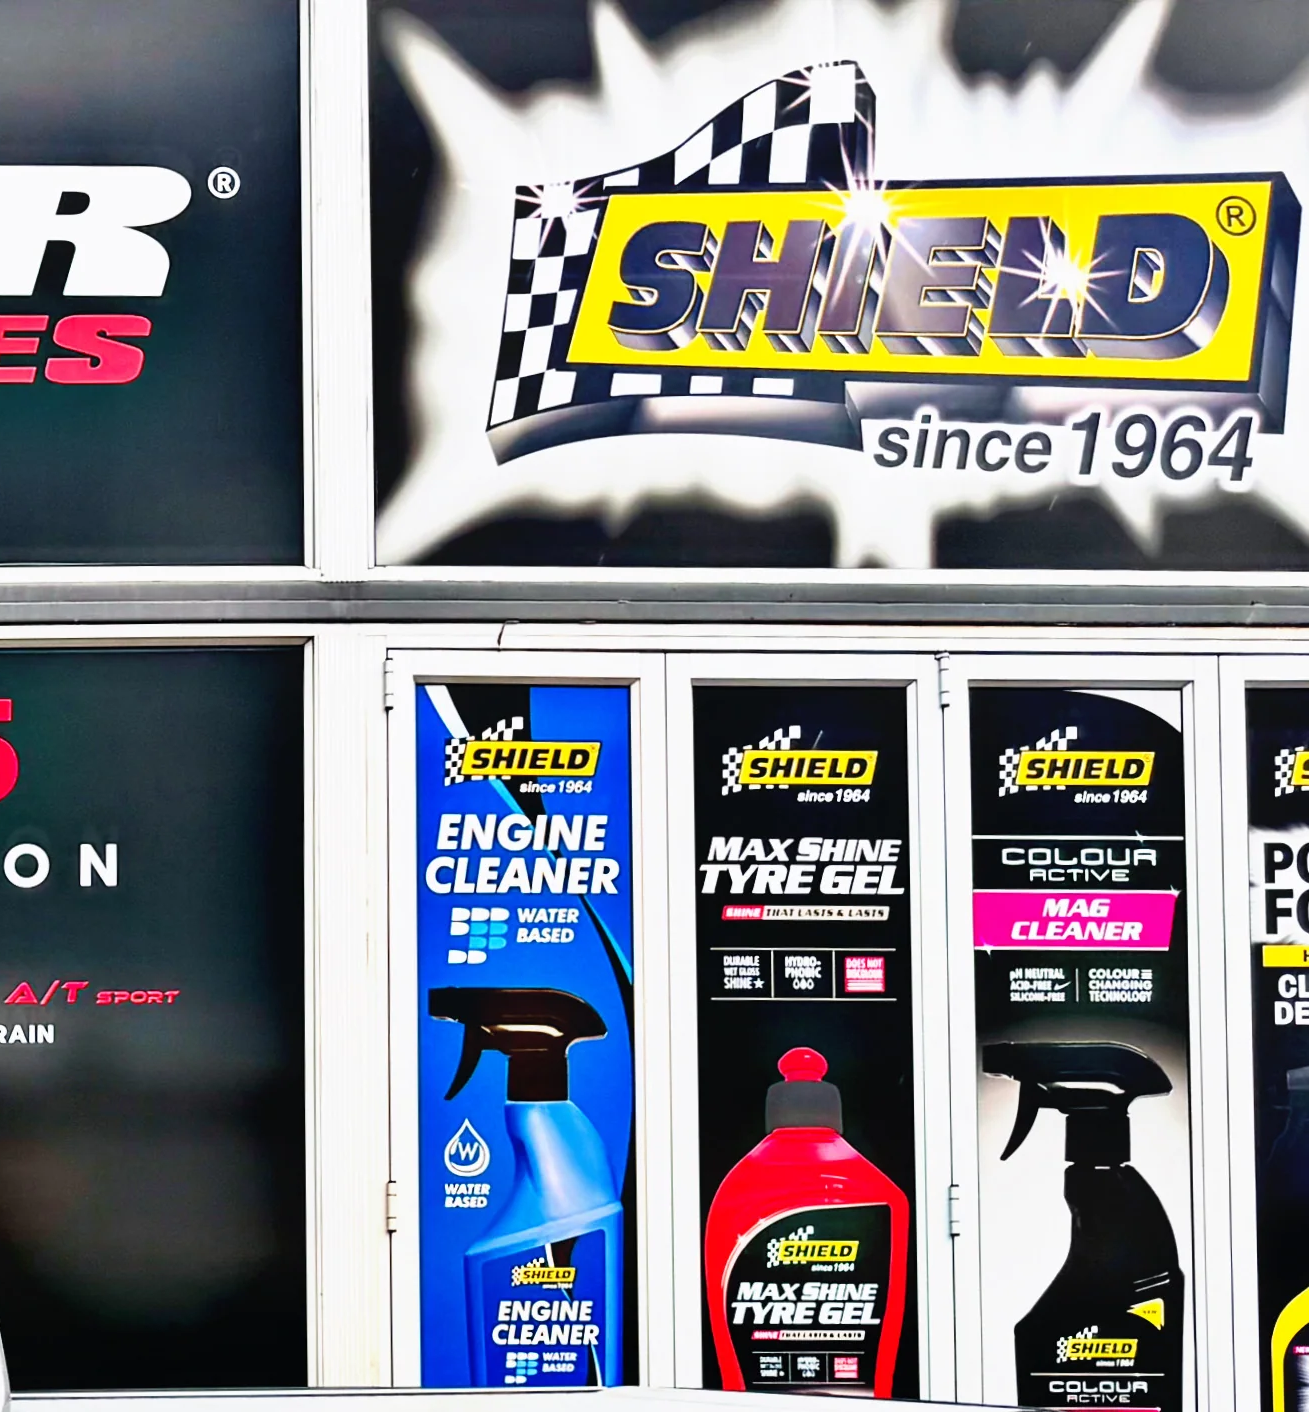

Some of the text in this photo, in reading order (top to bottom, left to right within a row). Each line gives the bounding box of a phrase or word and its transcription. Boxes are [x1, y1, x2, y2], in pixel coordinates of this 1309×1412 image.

[873, 412, 1255, 482] since 1964
[471, 747, 591, 770] SHIELD
[748, 757, 869, 779] SHIELD
[1025, 758, 1146, 780] SHIELD
[519, 780, 593, 794] since 1964
[796, 788, 871, 803] since 1964
[1074, 789, 1148, 803] since 1964
[436, 813, 608, 851] ENGINE
[706, 836, 902, 862] MAX SHINE
[1001, 847, 1157, 866] COLOUR
[425, 857, 620, 894] CLEANER
[698, 864, 905, 895] TYRE GEL
[1029, 868, 1130, 882] ACTIVE
[517, 907, 580, 923] WATER
[1042, 898, 1111, 918] MAG
[516, 928, 575, 943] BASED
[1010, 921, 1144, 941] CLEANER
[1024, 968, 1065, 979] NEUTRAL
[1088, 968, 1139, 979] COLOUR
[723, 977, 753, 989] SHINE
[1088, 980, 1153, 990] CHANGING
[3, 979, 90, 1006] A/T
[95, 989, 180, 1005] SPORT
[1088, 990, 1153, 1002] TECHNOLOGY
[444, 1183, 491, 1196] WATER
[444, 1196, 488, 1208] BASED
[783, 1244, 853, 1258] SHIELD
[523, 1270, 572, 1279] SHIELD
[736, 1282, 879, 1301] MAX SHINE
[497, 1300, 593, 1322] ENGINE
[731, 1302, 881, 1325] TYRE GEL
[491, 1324, 600, 1345] CLEANER
[1071, 1342, 1133, 1354] SHIELD
[542, 1351, 577, 1361] WATER
[1048, 1380, 1148, 1393] COLOUR
[1066, 1394, 1131, 1403] ACTIVE
